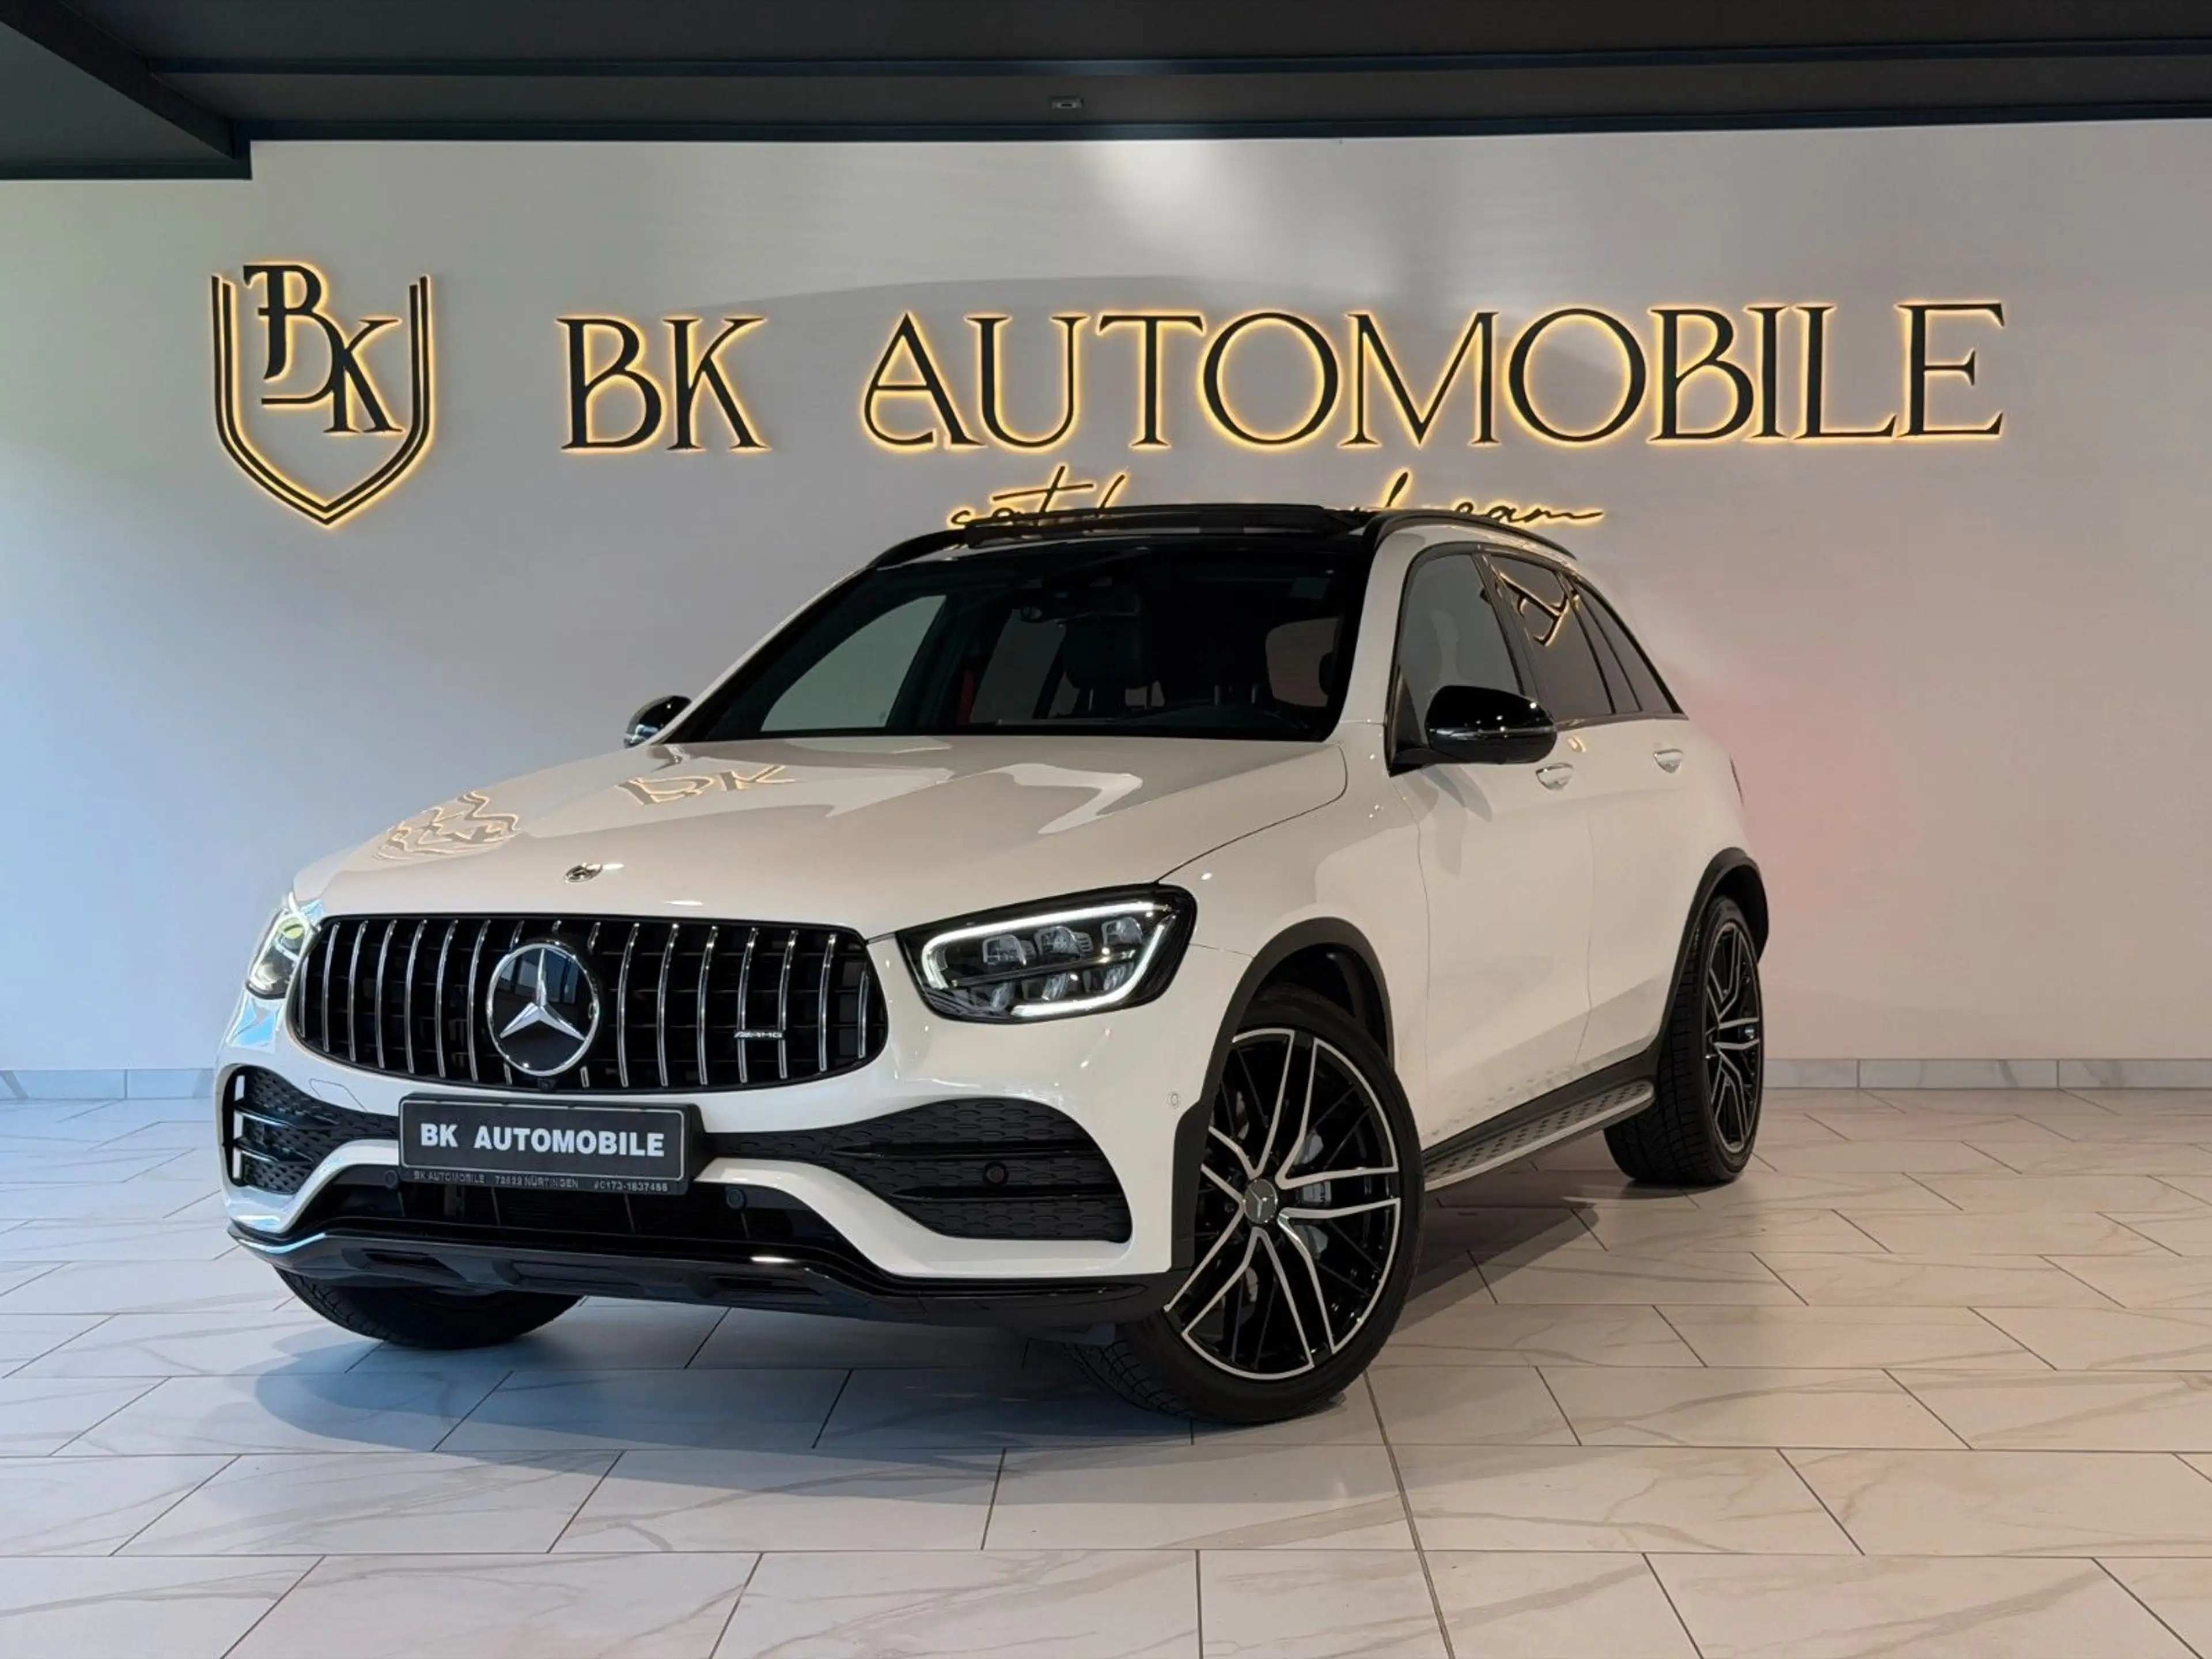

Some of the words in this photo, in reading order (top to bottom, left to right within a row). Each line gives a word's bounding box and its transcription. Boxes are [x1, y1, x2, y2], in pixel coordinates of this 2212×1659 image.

[556, 317, 770, 450] BK
[865, 301, 2005, 446] AUTOMOBILE
[421, 1123, 458, 1147] BK
[474, 1126, 665, 1157] AUTOMOBILE
[414, 1171, 426, 1180] BK
[428, 1172, 484, 1183] AUTOMOBILE
